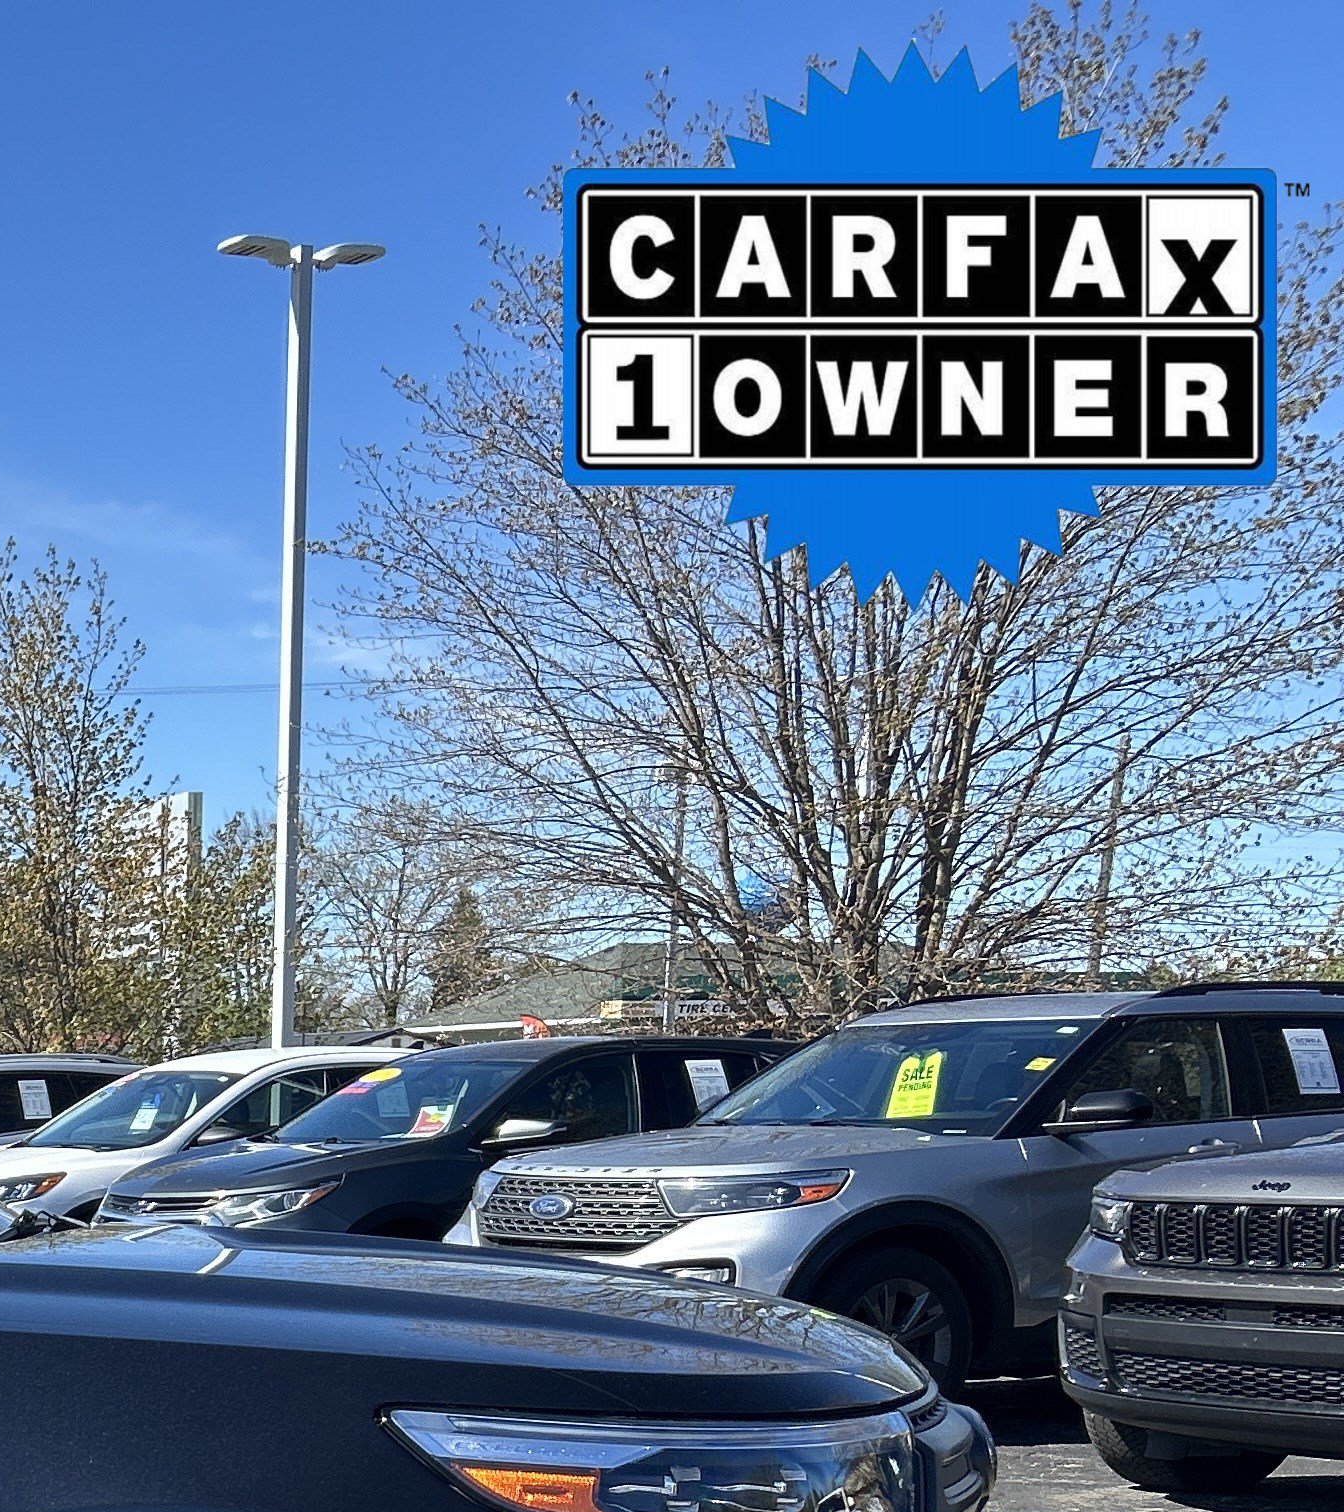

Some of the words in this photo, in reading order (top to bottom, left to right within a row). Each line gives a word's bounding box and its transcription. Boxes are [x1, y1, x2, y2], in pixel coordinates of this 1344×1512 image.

[678, 1003, 706, 1014] TIRE
[901, 1065, 935, 1083] SALE
[897, 1081, 933, 1092] PENDING
[1252, 1180, 1292, 1193] Jeep
